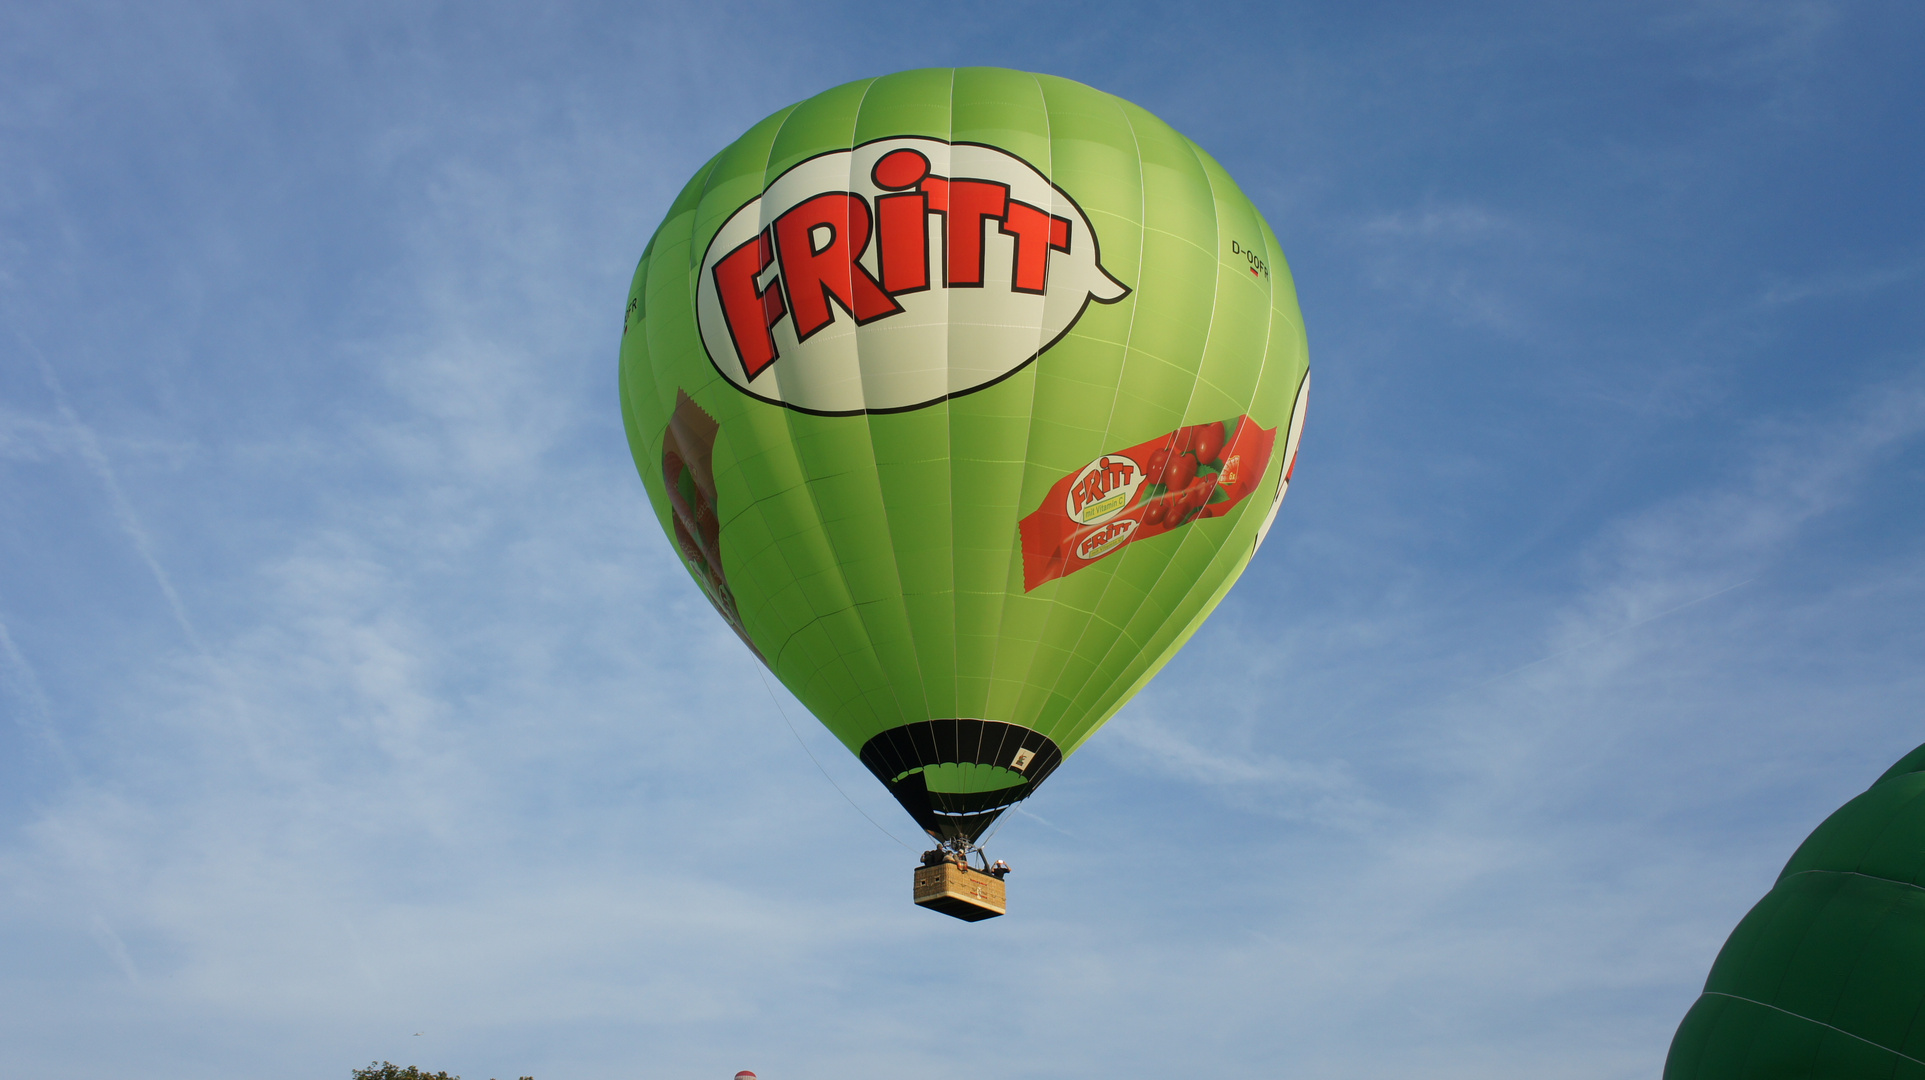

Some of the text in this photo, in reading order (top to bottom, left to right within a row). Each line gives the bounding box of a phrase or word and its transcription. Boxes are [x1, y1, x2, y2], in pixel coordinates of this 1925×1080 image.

[1085, 496, 1124, 519] mit Vitamin C
